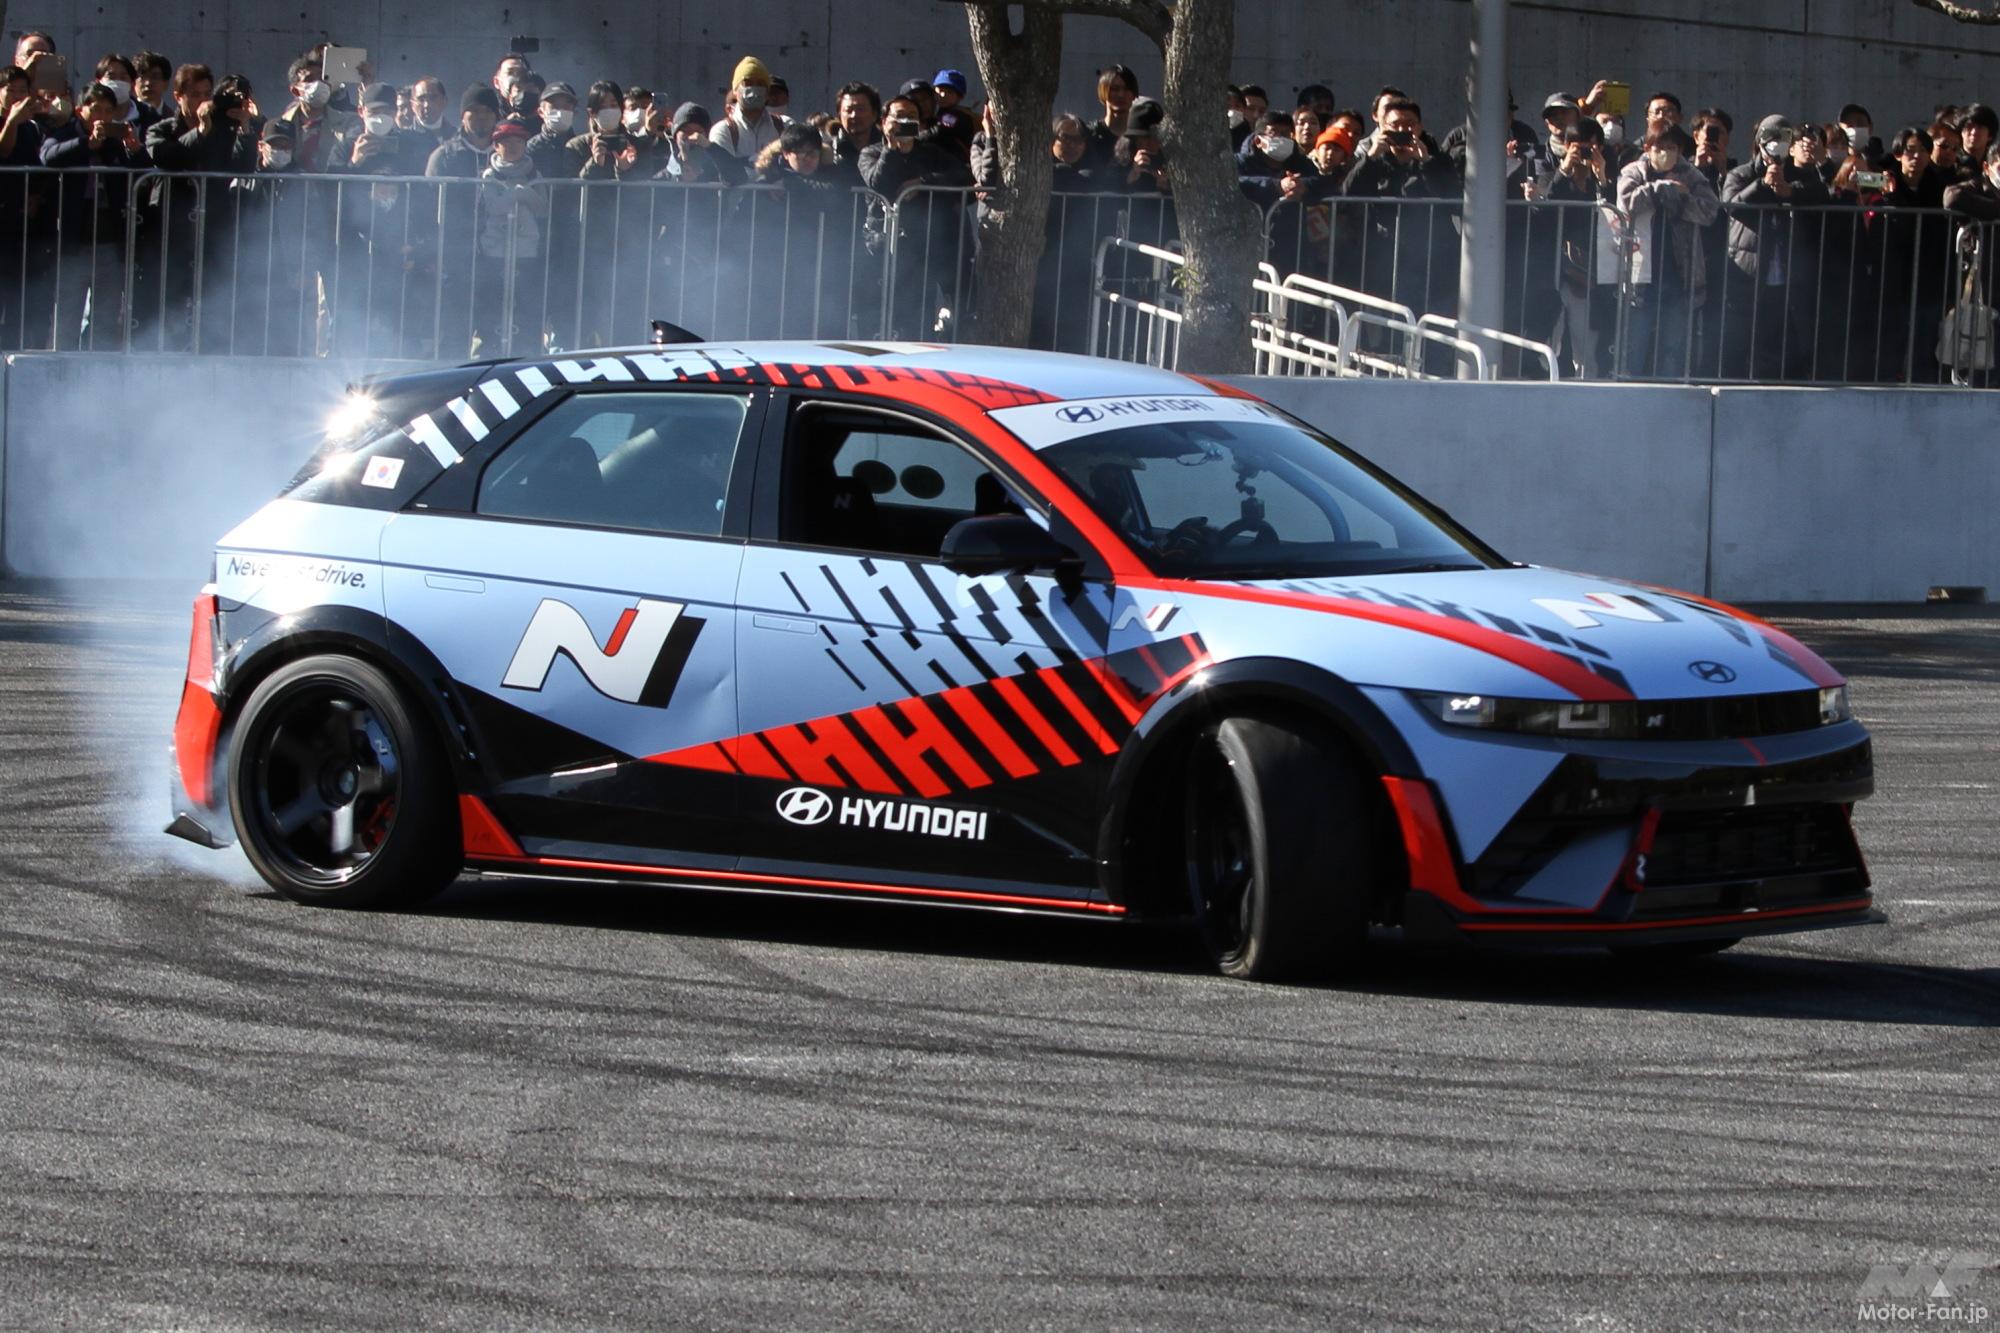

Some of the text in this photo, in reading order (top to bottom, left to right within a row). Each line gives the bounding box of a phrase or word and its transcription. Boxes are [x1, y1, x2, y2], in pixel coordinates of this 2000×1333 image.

[1100, 398, 1214, 416] HYUNDAI
[226, 556, 275, 577] Neve
[315, 563, 367, 589] drive.
[1112, 602, 1182, 632] N
[1529, 592, 1683, 629] N
[500, 597, 707, 709] N
[839, 796, 988, 841] HYUNDAI
